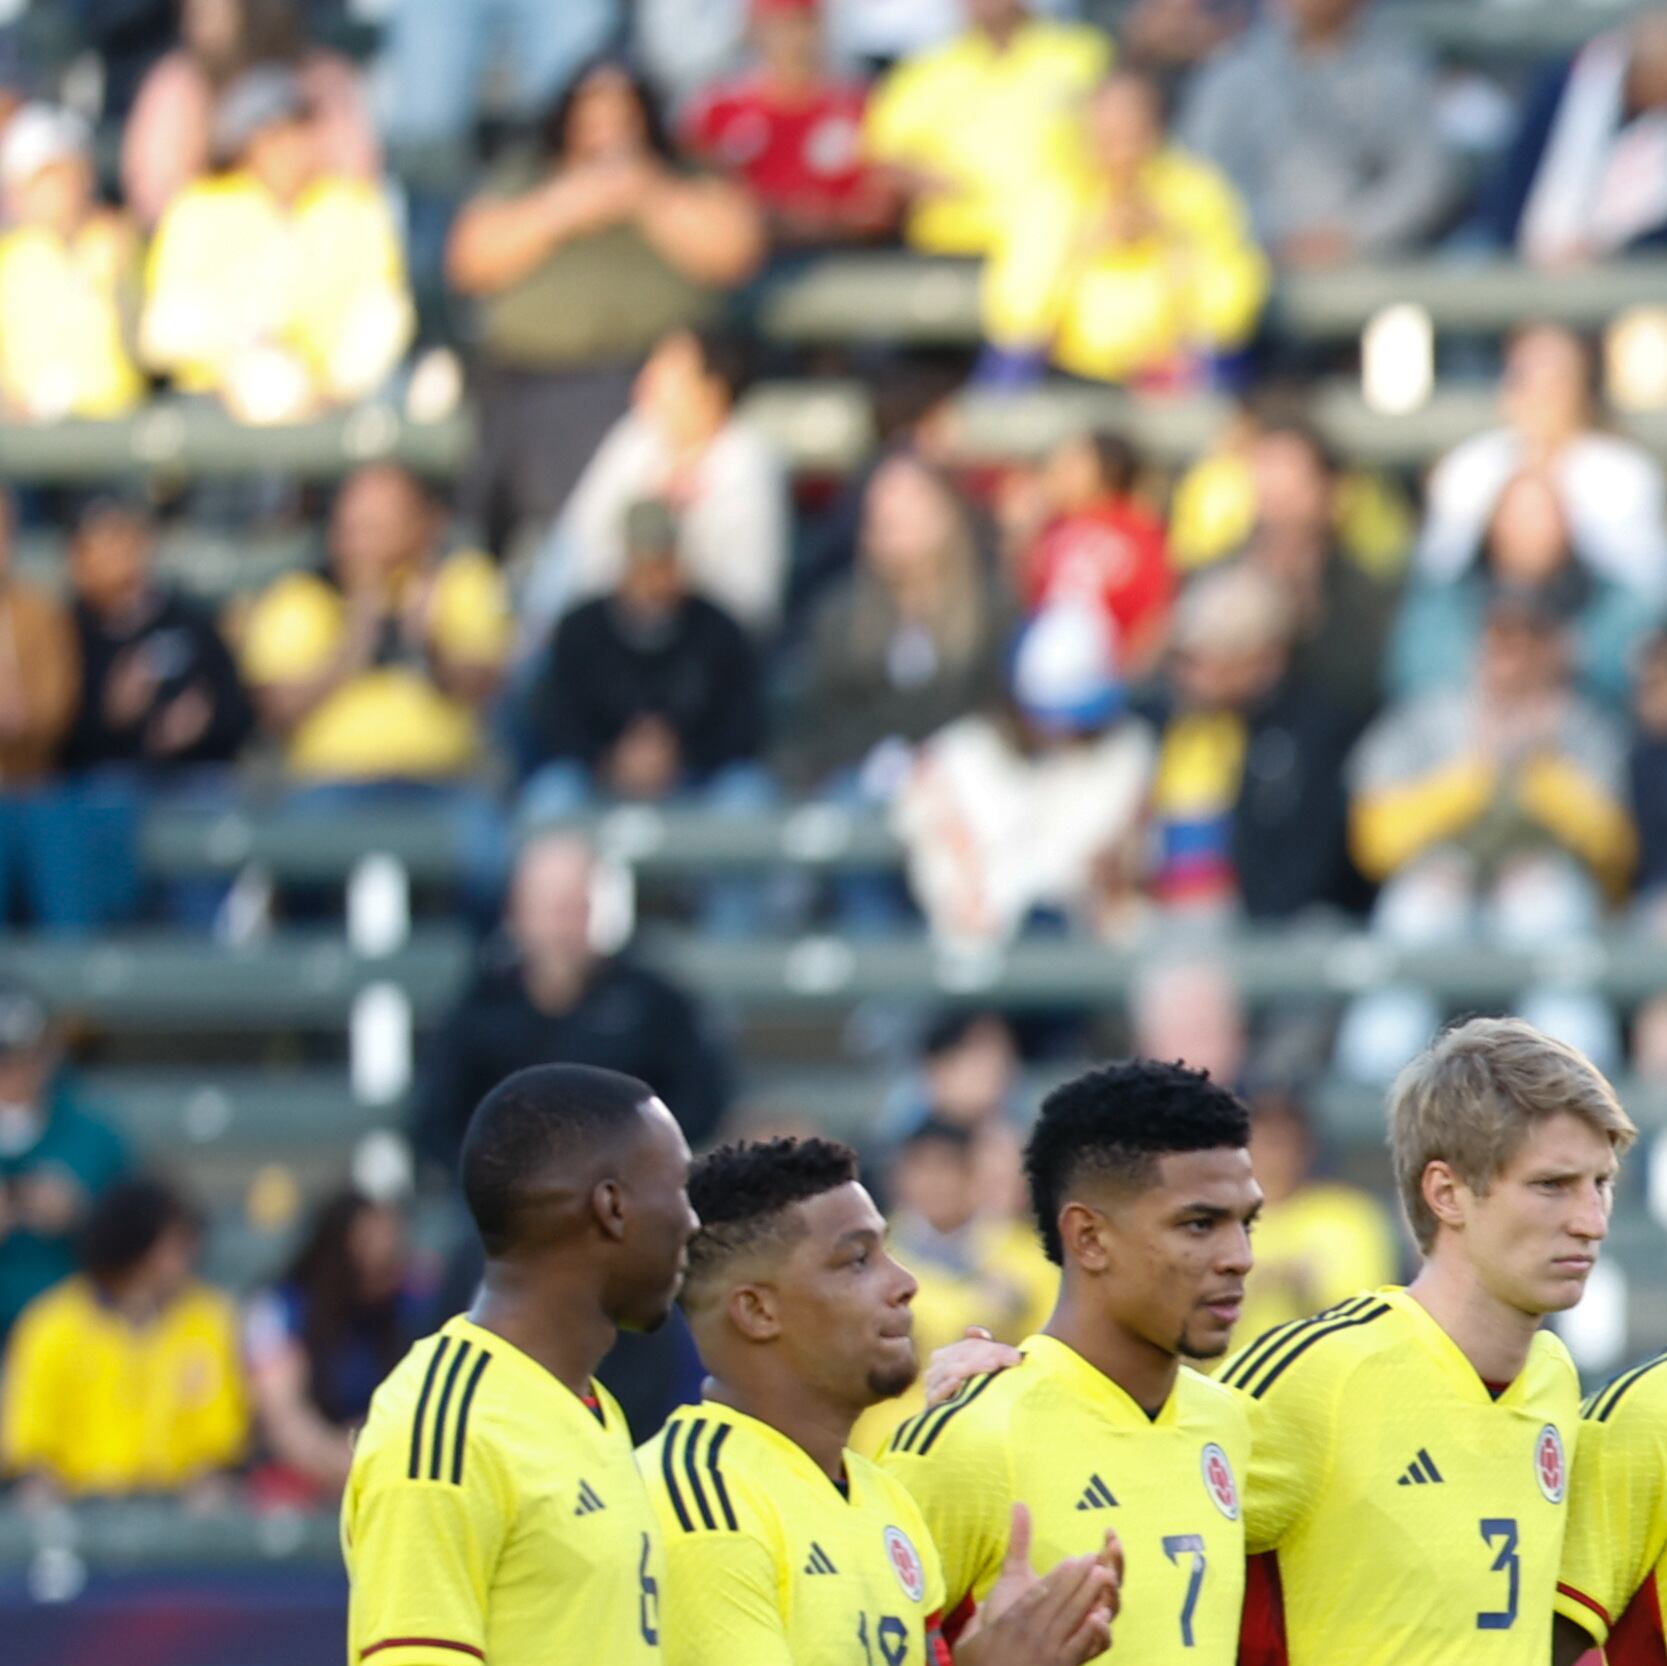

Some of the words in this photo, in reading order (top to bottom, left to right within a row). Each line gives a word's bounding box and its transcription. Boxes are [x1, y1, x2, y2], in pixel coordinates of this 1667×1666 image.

[639, 1532, 659, 1646] 6
[1161, 1533, 1207, 1648] 7
[1477, 1518, 1521, 1630] 3
